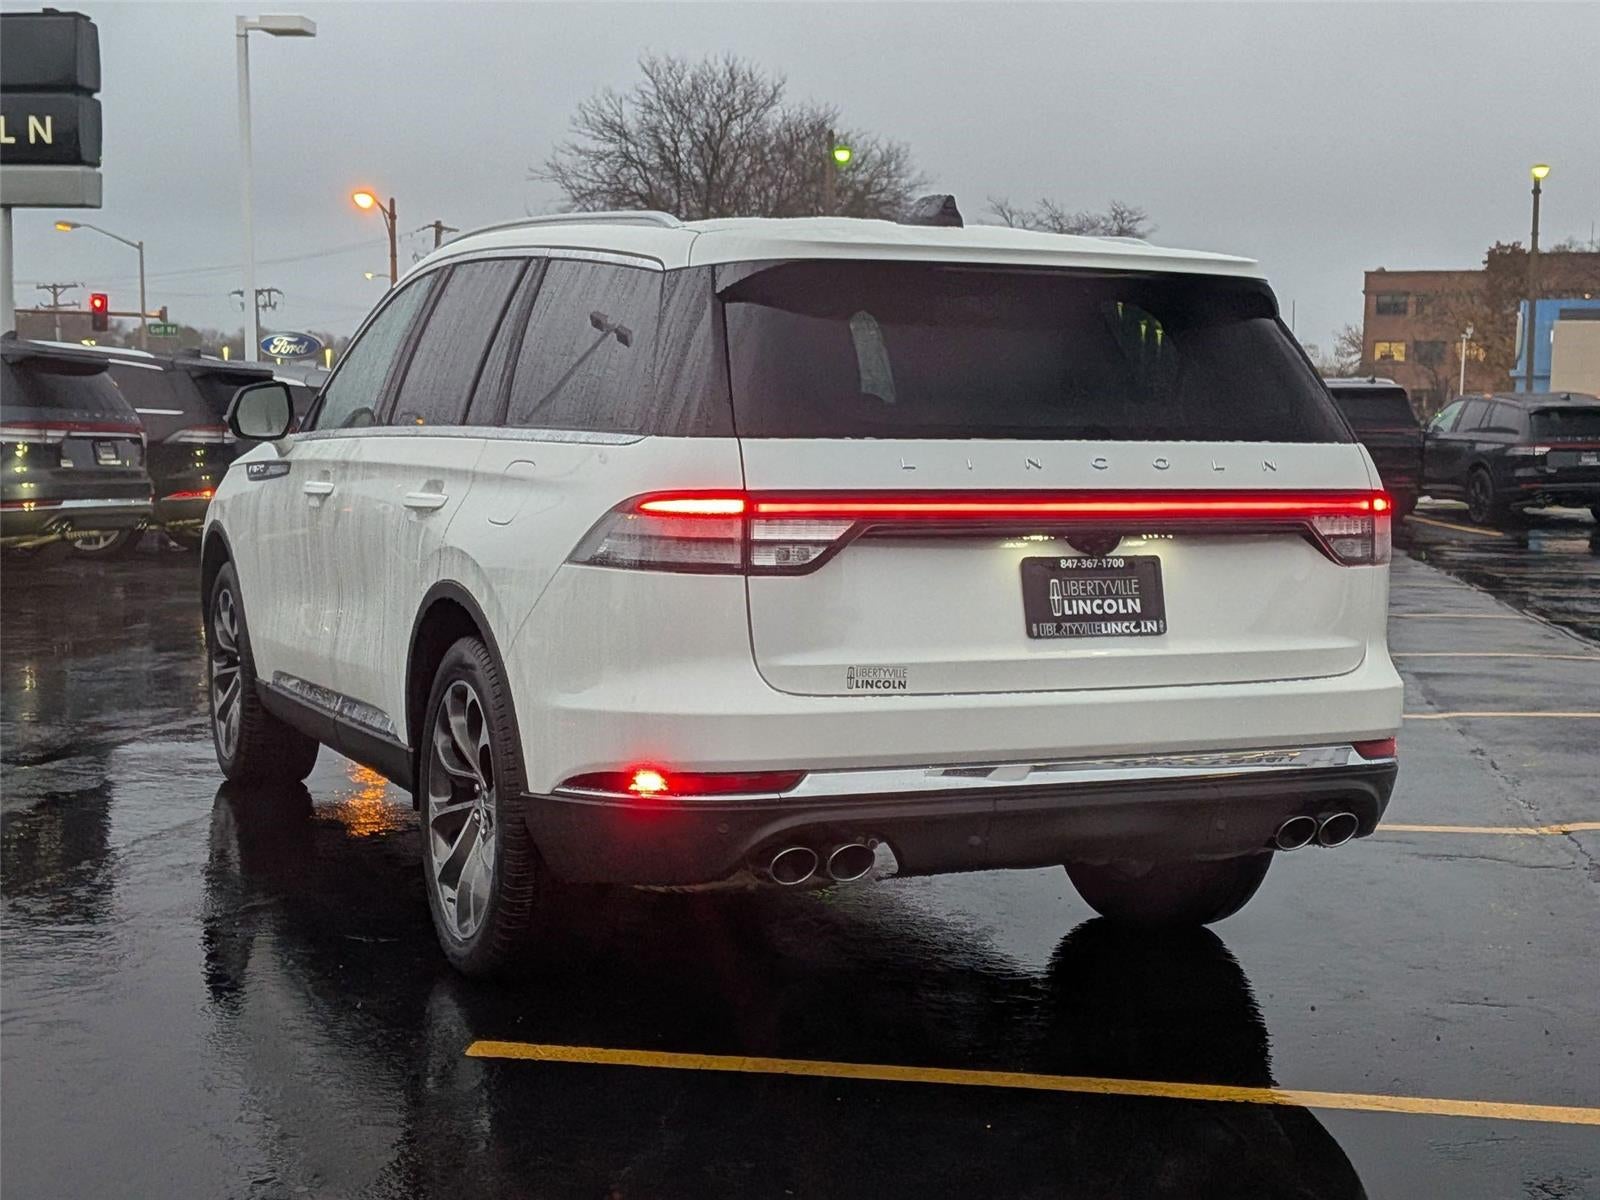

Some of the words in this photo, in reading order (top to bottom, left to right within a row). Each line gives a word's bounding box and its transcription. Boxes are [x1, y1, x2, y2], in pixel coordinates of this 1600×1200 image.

[0, 115, 52, 145] LN
[270, 336, 308, 354] Ford
[901, 456, 1277, 473] LINCOLN
[1060, 558, 1125, 569] 847-367-1700
[1062, 579, 1140, 596] LIBERTYVILLE
[1064, 599, 1142, 615] LINCOLN
[855, 667, 908, 679] LIBERTYVILLE
[855, 679, 907, 689] LINCOLN
